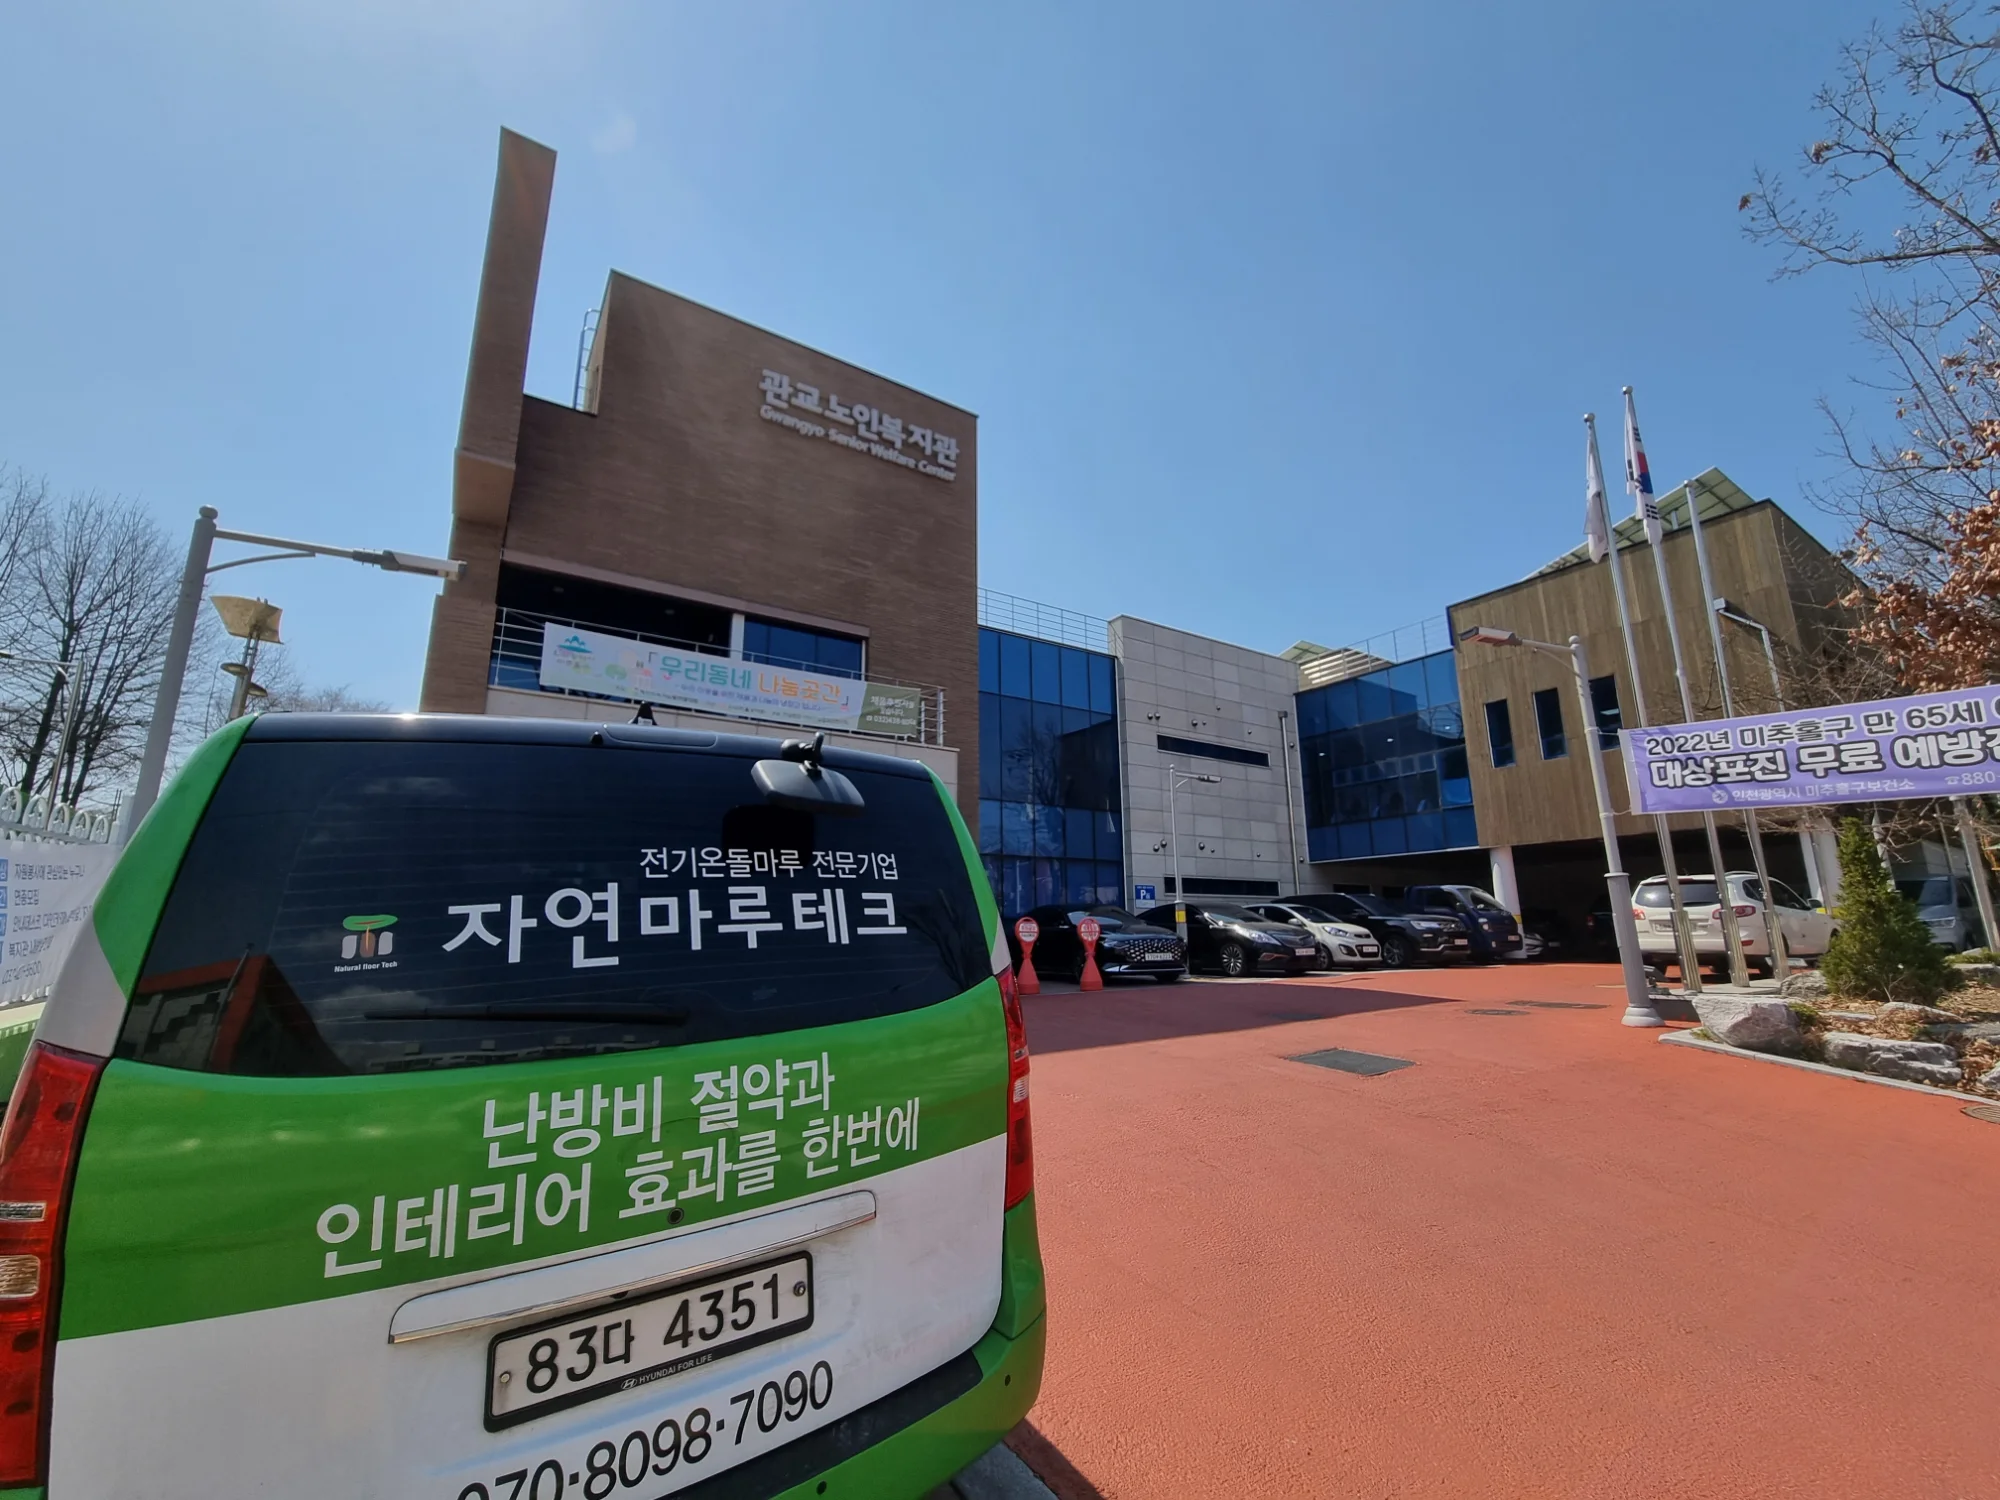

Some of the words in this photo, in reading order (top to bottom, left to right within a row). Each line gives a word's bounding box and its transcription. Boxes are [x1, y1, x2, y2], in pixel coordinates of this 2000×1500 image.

[759, 368, 960, 468] 관교노인복지관
[760, 404, 824, 438] Gwangyo
[828, 427, 869, 451] Senior
[870, 444, 916, 469] Welfare
[918, 459, 956, 481] Center
[1645, 729, 1732, 757] 2022년
[1738, 715, 1855, 747] 미추홀구
[1862, 710, 1897, 735] 만
[1904, 699, 1985, 730] 65세
[1648, 749, 1790, 789] 대상포진
[1798, 740, 1884, 778] 무료
[1733, 786, 1800, 801] 인천광역시
[1806, 778, 1916, 798] 미추홀구보건소
[639, 846, 804, 879] 전기온돌마루
[811, 850, 899, 881] 전문기업
[441, 881, 908, 968] 자연마루테크
[334, 964, 361, 973] Natural
[362, 962, 380, 971] floor
[381, 960, 398, 968] Tech
[482, 1075, 664, 1169] 난방비
[690, 1051, 836, 1135] 절약과
[316, 1162, 593, 1279] 인테리어
[619, 1127, 782, 1220] 효과를
[802, 1096, 920, 1179] 한번에
[526, 1319, 635, 1394] 83다
[663, 1273, 780, 1349] 4351
[639, 1365, 676, 1384] HYUNDAI
[677, 1359, 695, 1371] FOR
[696, 1353, 713, 1365] LIFE
